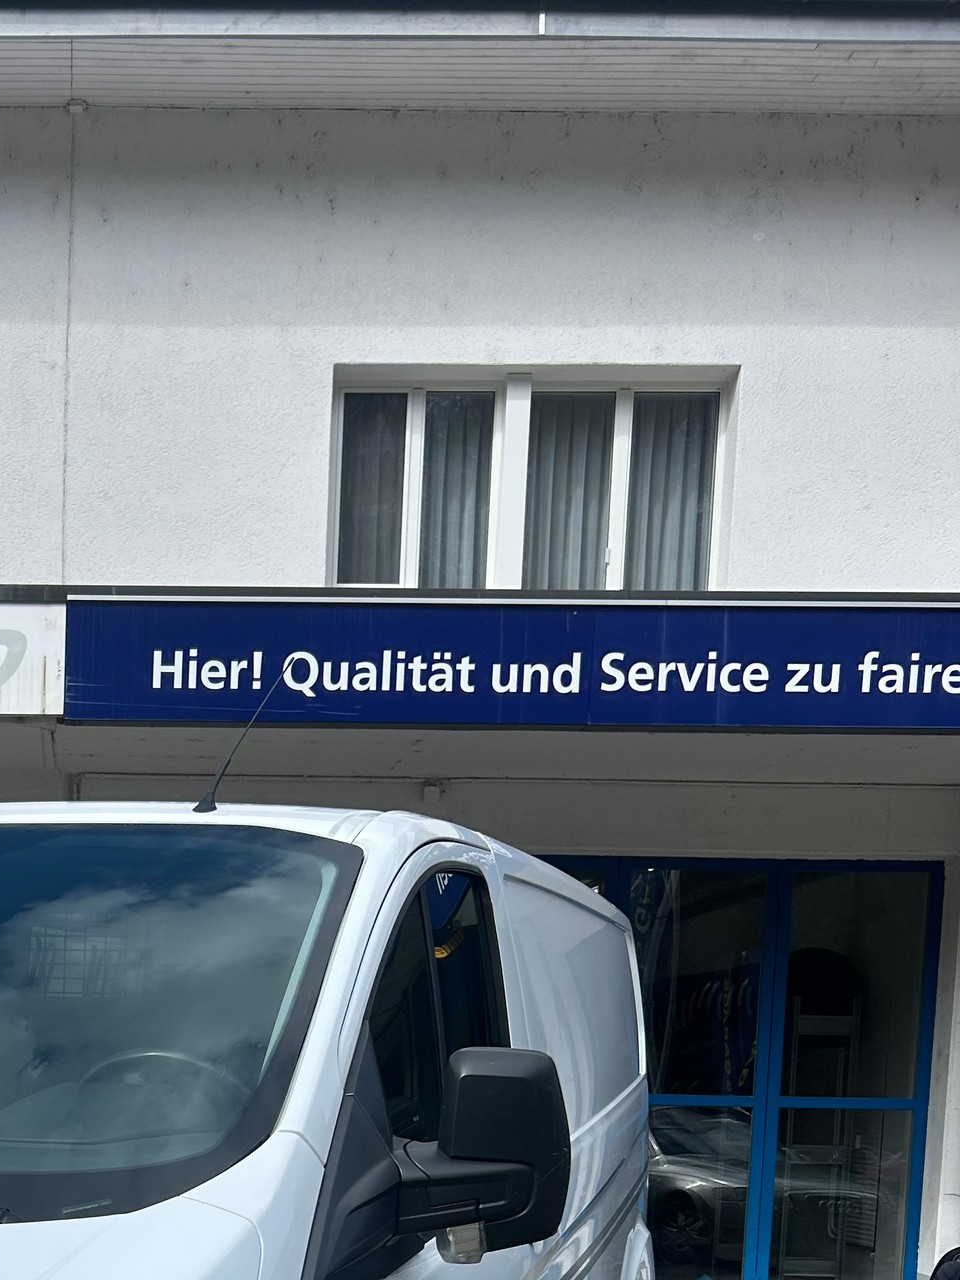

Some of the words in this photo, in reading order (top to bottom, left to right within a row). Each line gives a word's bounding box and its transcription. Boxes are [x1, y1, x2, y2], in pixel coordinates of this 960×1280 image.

[151, 648, 263, 690] Hier!
[282, 648, 476, 697] Qualität
[490, 652, 582, 694] und
[599, 651, 770, 694] Service
[784, 662, 841, 693] zu
